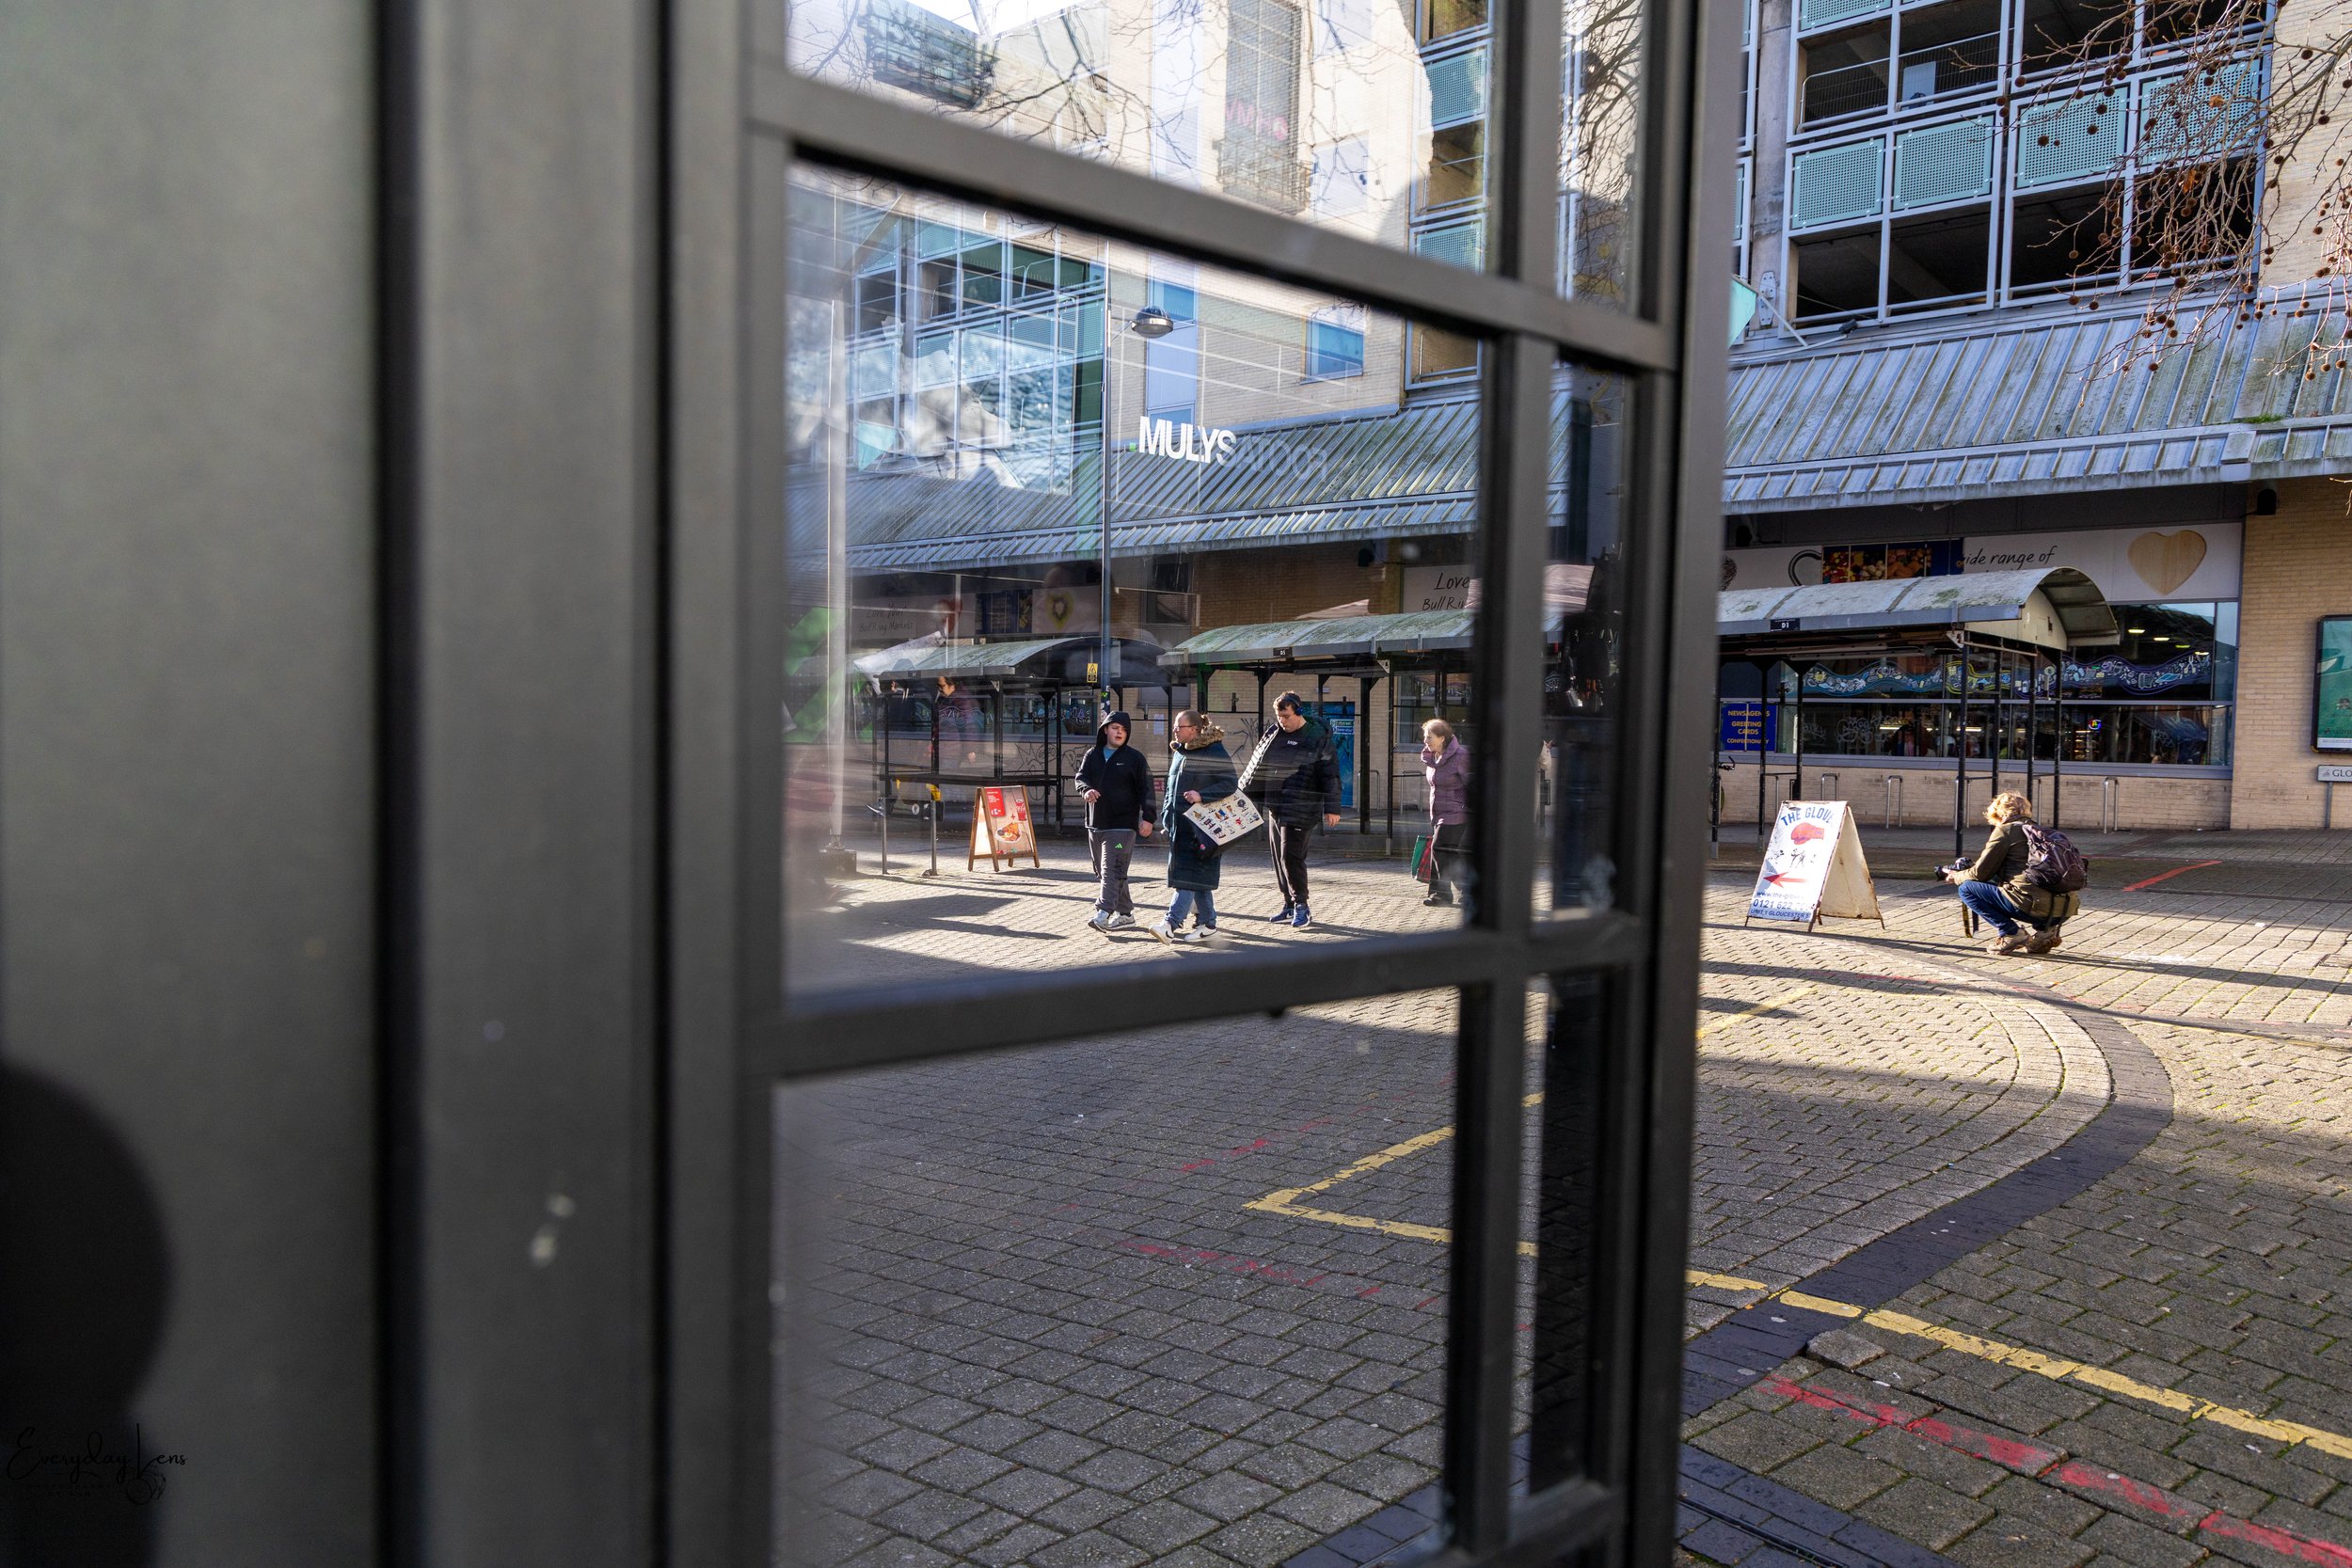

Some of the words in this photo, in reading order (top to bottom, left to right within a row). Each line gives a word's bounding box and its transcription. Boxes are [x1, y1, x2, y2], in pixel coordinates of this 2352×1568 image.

[1990, 551, 2034, 571] range
[2038, 546, 2058, 565] of
[1433, 572, 1470, 591] Love
[1422, 595, 1446, 611] Bull
[1780, 810, 1802, 826] THE
[1753, 898, 1774, 909] 0121
[1776, 900, 1793, 911] 622
